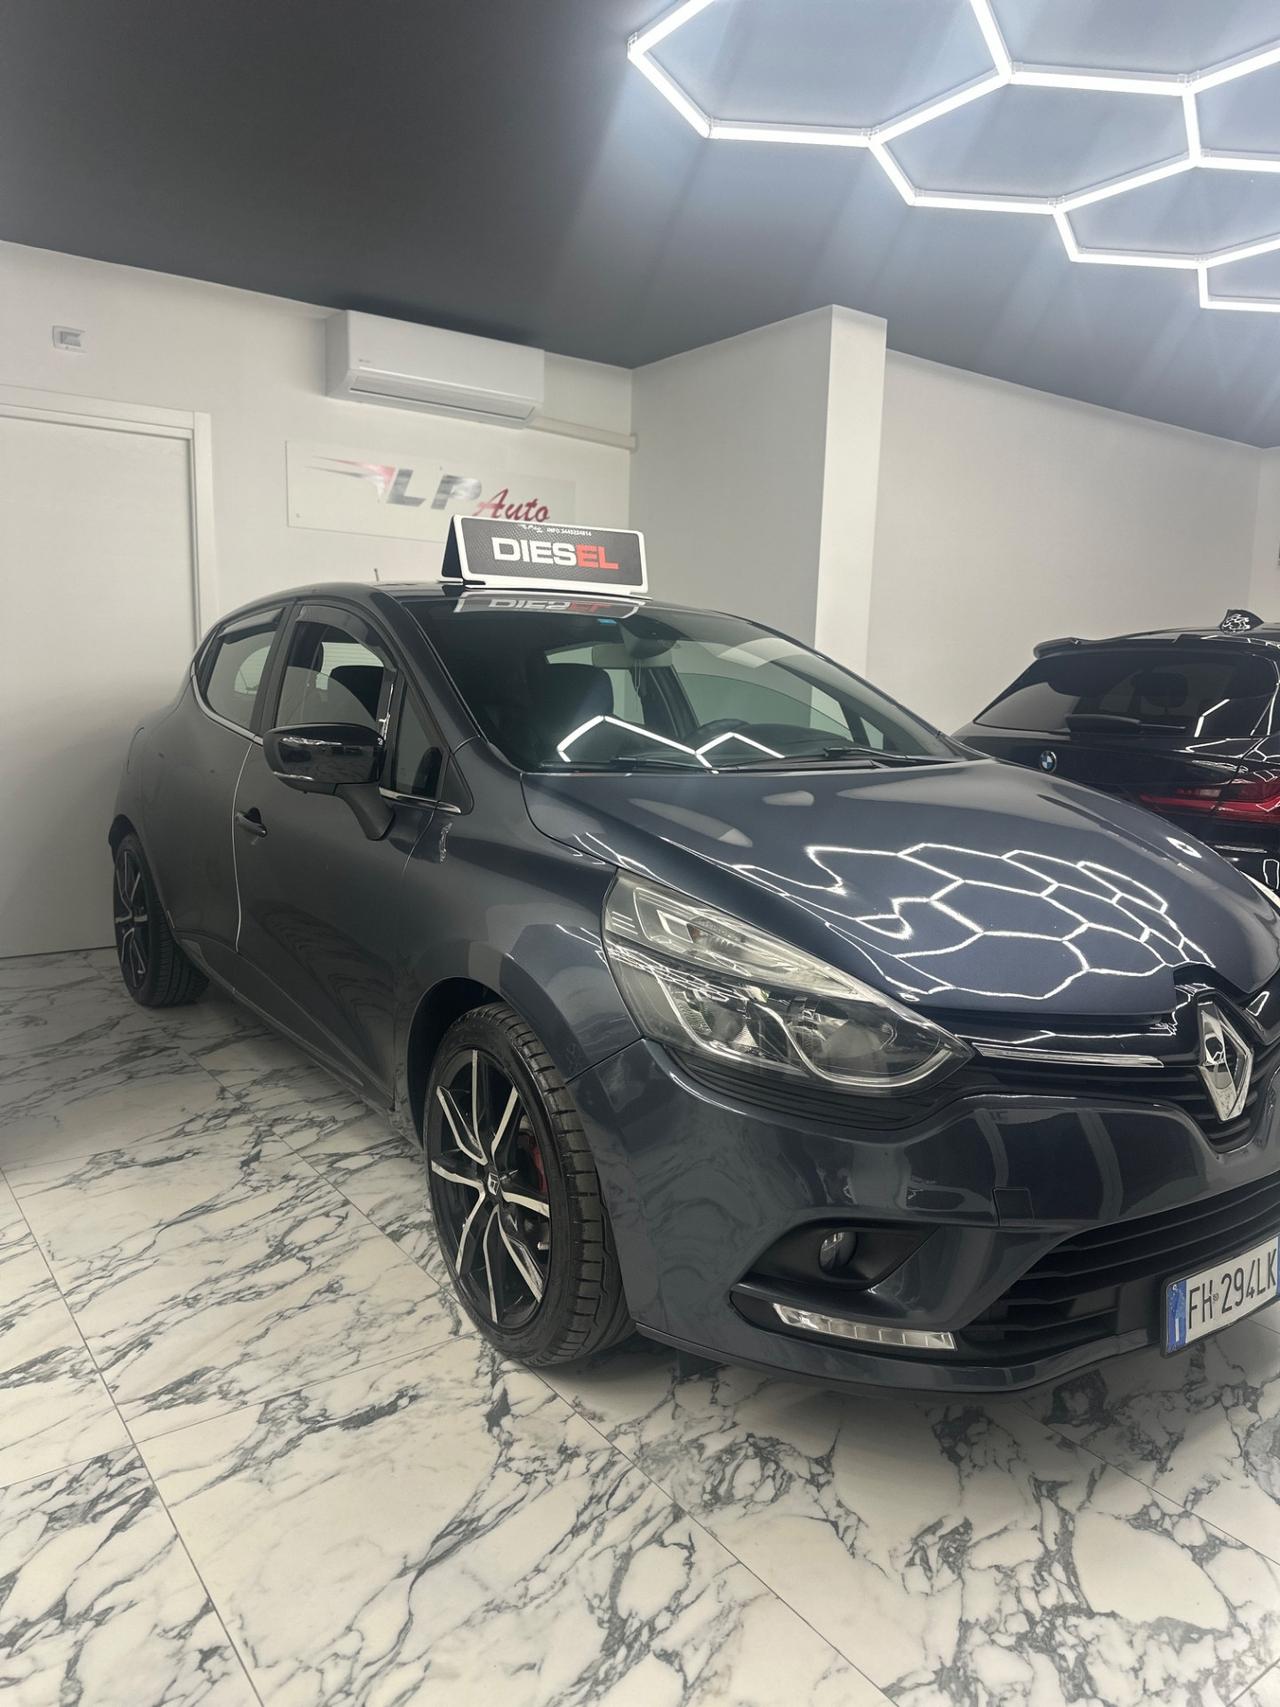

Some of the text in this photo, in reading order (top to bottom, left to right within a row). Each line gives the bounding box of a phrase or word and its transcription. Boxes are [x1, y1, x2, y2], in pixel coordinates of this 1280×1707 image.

[386, 468, 550, 523] LP Auto
[491, 536, 619, 570] DIESEL
